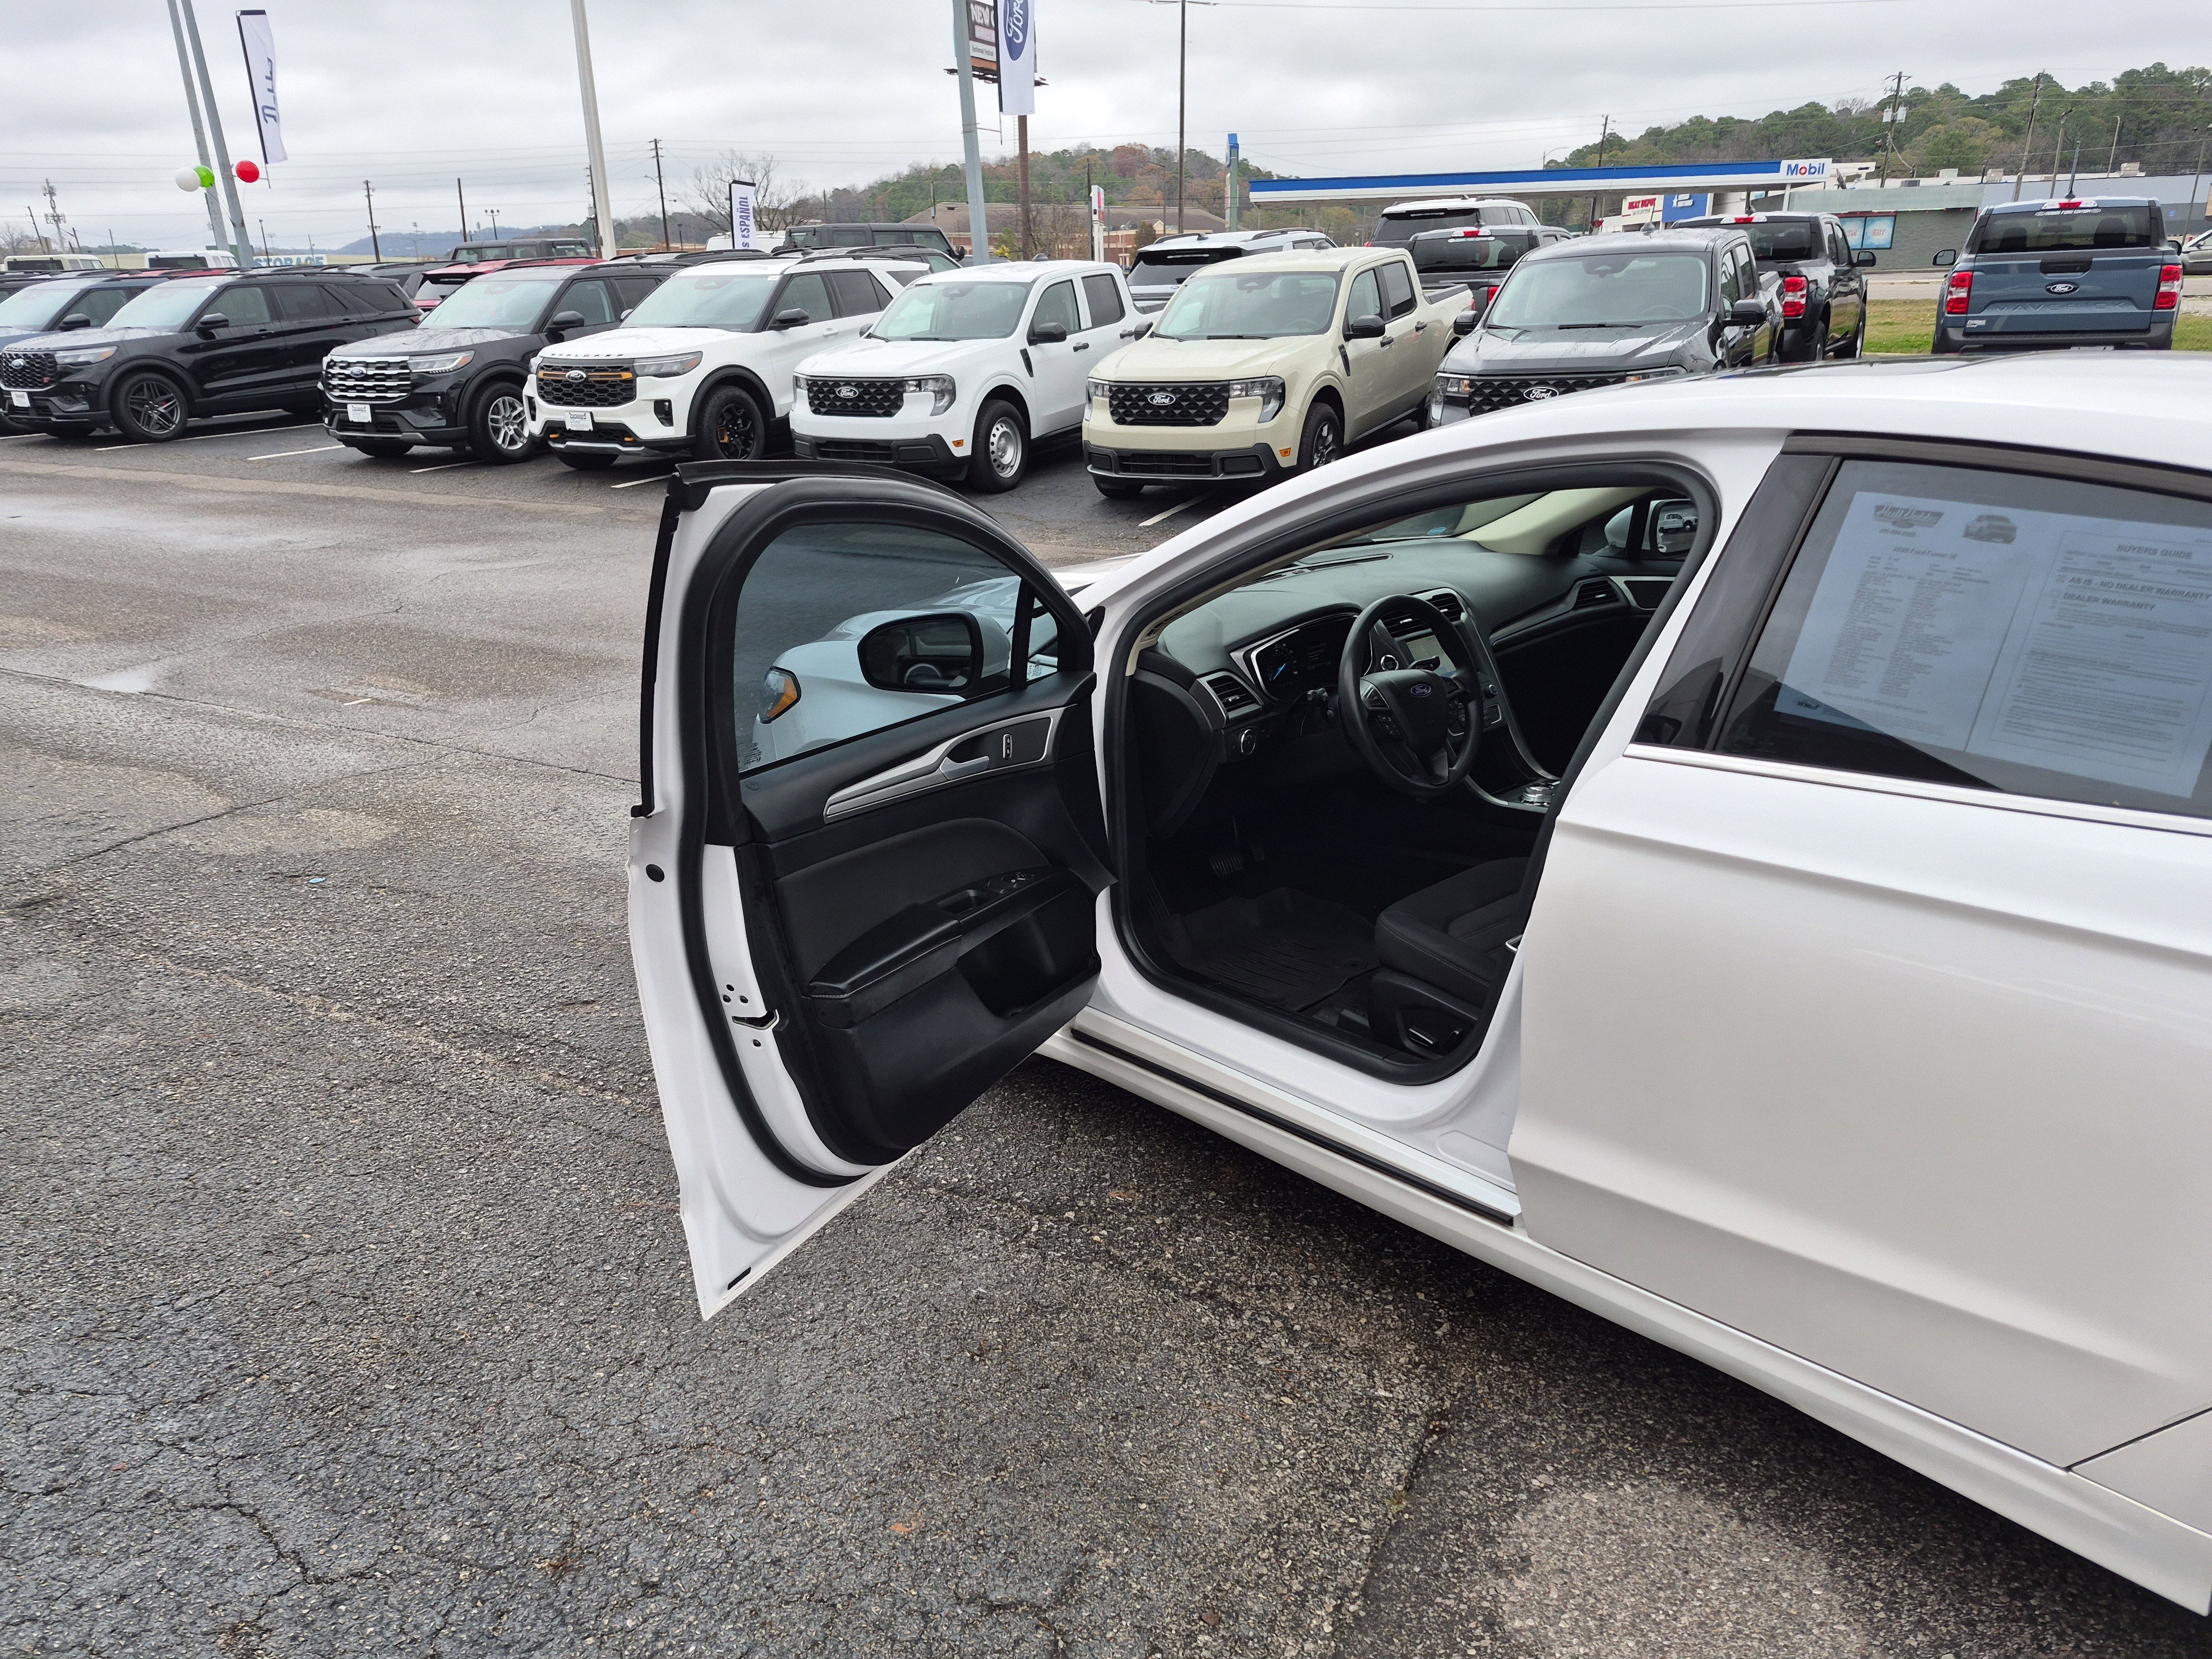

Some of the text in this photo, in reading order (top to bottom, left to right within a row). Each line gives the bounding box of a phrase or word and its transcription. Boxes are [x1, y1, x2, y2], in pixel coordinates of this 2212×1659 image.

[1006, 0, 1024, 43] For
[1786, 163, 1825, 176] Mobil
[737, 196, 750, 238] ESPAÑOL
[2116, 544, 2193, 560] BUYERS GUIDE
[2099, 580, 2114, 589] NO
[2115, 583, 2154, 594] DEALER
[2155, 587, 2211, 600] WARRANTY
[2063, 592, 2156, 611] DEALER WARRANTY
